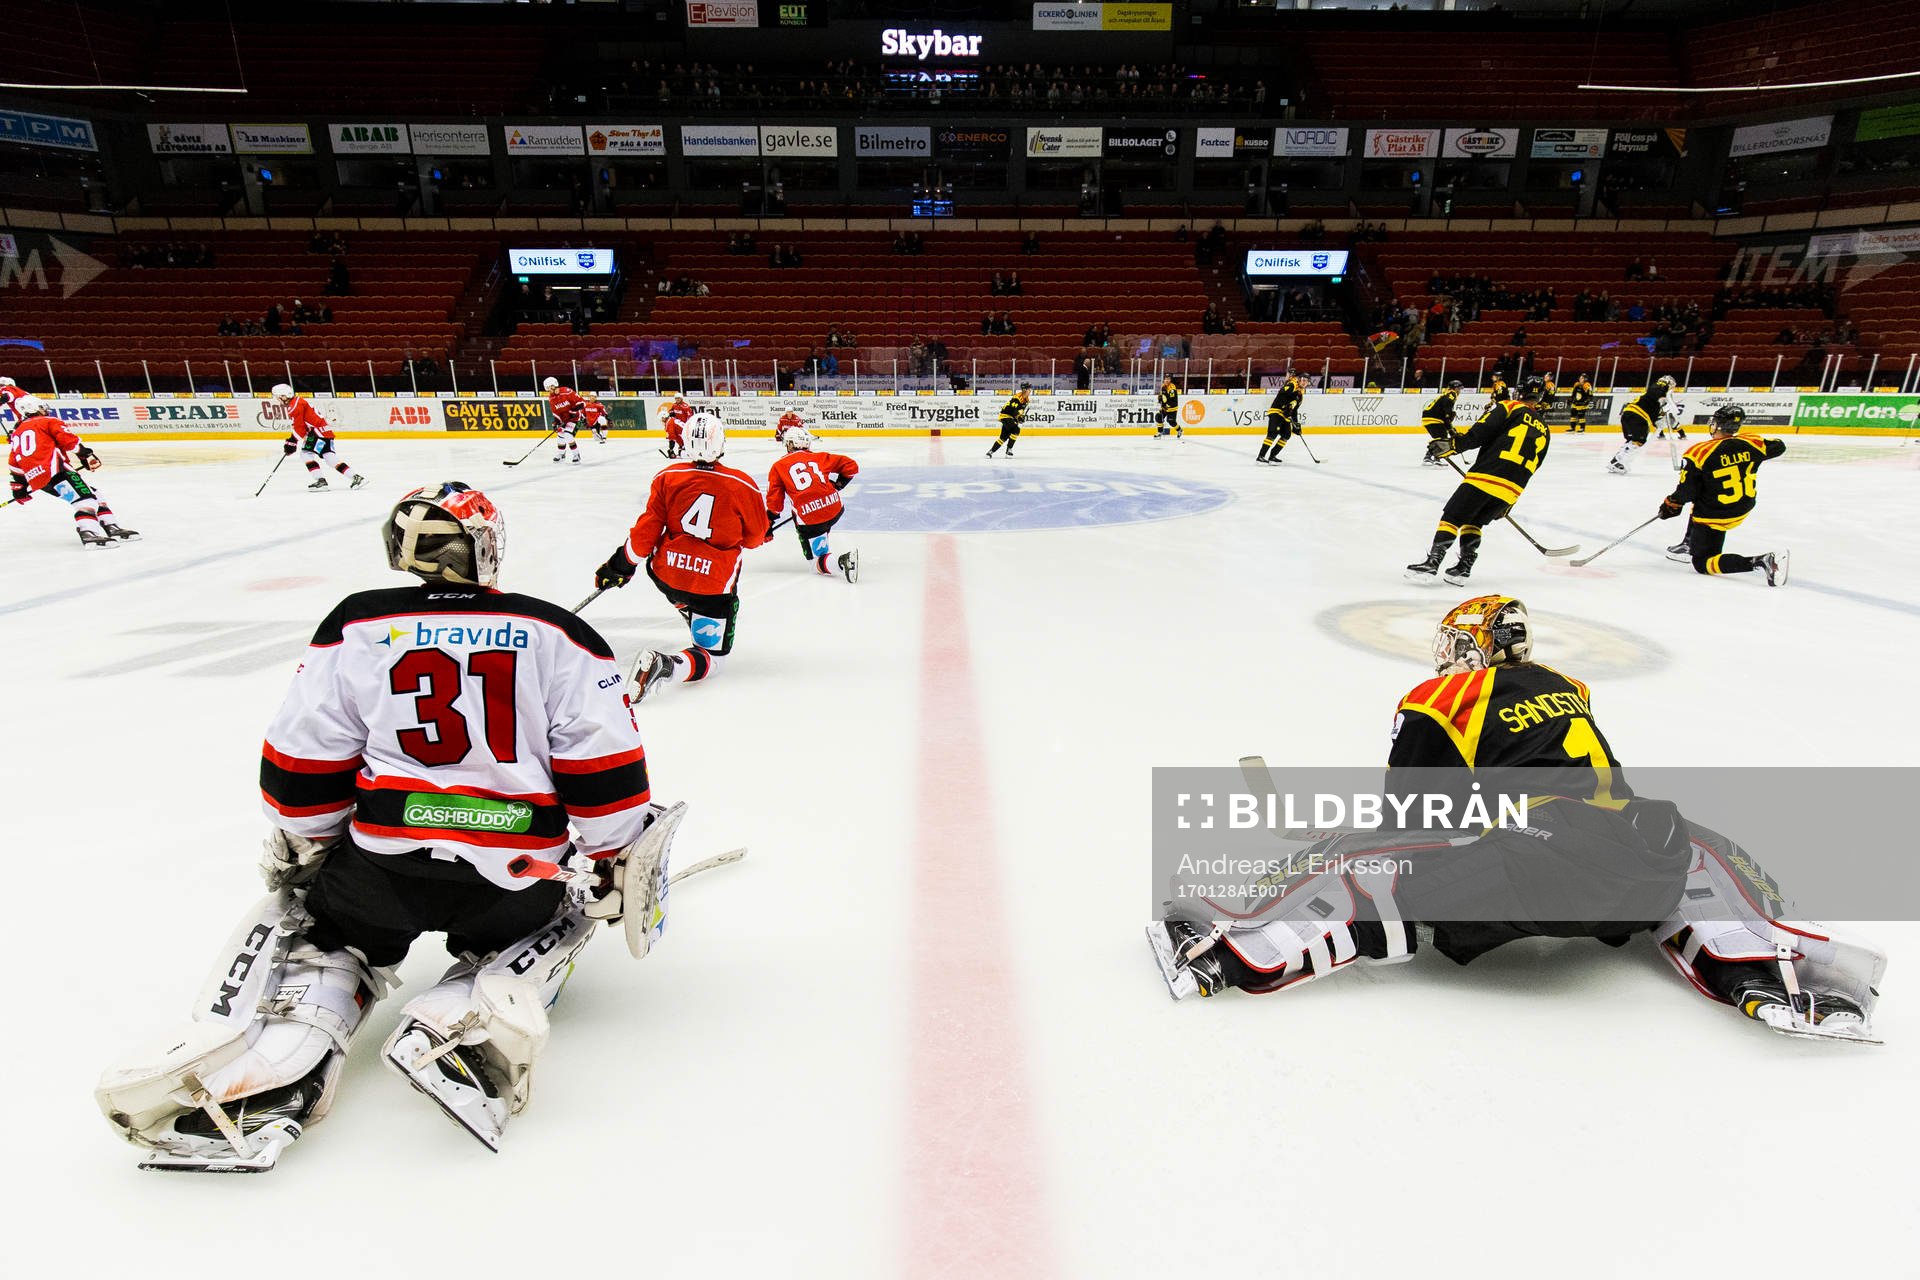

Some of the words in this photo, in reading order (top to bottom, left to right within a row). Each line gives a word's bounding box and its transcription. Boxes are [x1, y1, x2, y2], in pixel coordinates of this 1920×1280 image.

[707, 4, 755, 17] Revision
[1038, 9, 1066, 18] ECKERÖ
[1075, 10, 1098, 18] LINJEN
[882, 29, 983, 59] Skybar
[261, 135, 305, 143] Maskiner
[341, 127, 399, 142] ABAB
[413, 131, 485, 142] Horisonterra
[528, 135, 582, 145] Ramudden
[684, 136, 757, 146] Handelsbanken
[766, 131, 833, 151] gavle.se
[859, 133, 926, 150] Bilmetro
[957, 133, 1007, 142] ENERCO
[1039, 134, 1063, 143] Svensk
[1285, 130, 1338, 145] NORDIC
[1386, 134, 1427, 143] Gästrike
[1108, 138, 1163, 147] BILBOLAGET
[1409, 143, 1425, 152] AB
[1733, 133, 1826, 153] BILLERUDKORSNÄS
[528, 256, 567, 266] Nilfisk
[1264, 257, 1301, 267] Nilfisk
[146, 405, 228, 420] PEAB
[446, 402, 501, 417] GÄVLE
[503, 403, 542, 417] TAXI
[886, 402, 908, 411] Fred
[908, 405, 980, 422] Trygghet
[1057, 400, 1098, 414] Familj
[1798, 402, 1897, 419] interlan
[389, 406, 431, 425] ABB
[726, 418, 767, 426] Utbildning
[821, 410, 858, 420] Kärlek
[1116, 408, 1156, 424] Frih
[1334, 414, 1399, 426] TRELLEBORG
[461, 417, 473, 430] 12
[482, 417, 503, 430] 90
[507, 417, 529, 430] 00
[1523, 413, 1548, 436] CLARK
[1720, 451, 1751, 467] ÖLUND
[788, 461, 827, 491] 61
[800, 492, 840, 516] JADELAND
[680, 492, 716, 541] 4
[666, 550, 713, 576] WELCH
[427, 592, 478, 600] CCM
[415, 621, 529, 649] bravida
[389, 646, 518, 768] 31
[1562, 717, 1630, 811] 1
[406, 806, 518, 829] CASHBUDDY
[506, 917, 576, 976] CCM
[211, 923, 275, 1017] CCM
[276, 989, 303, 997] CCM
